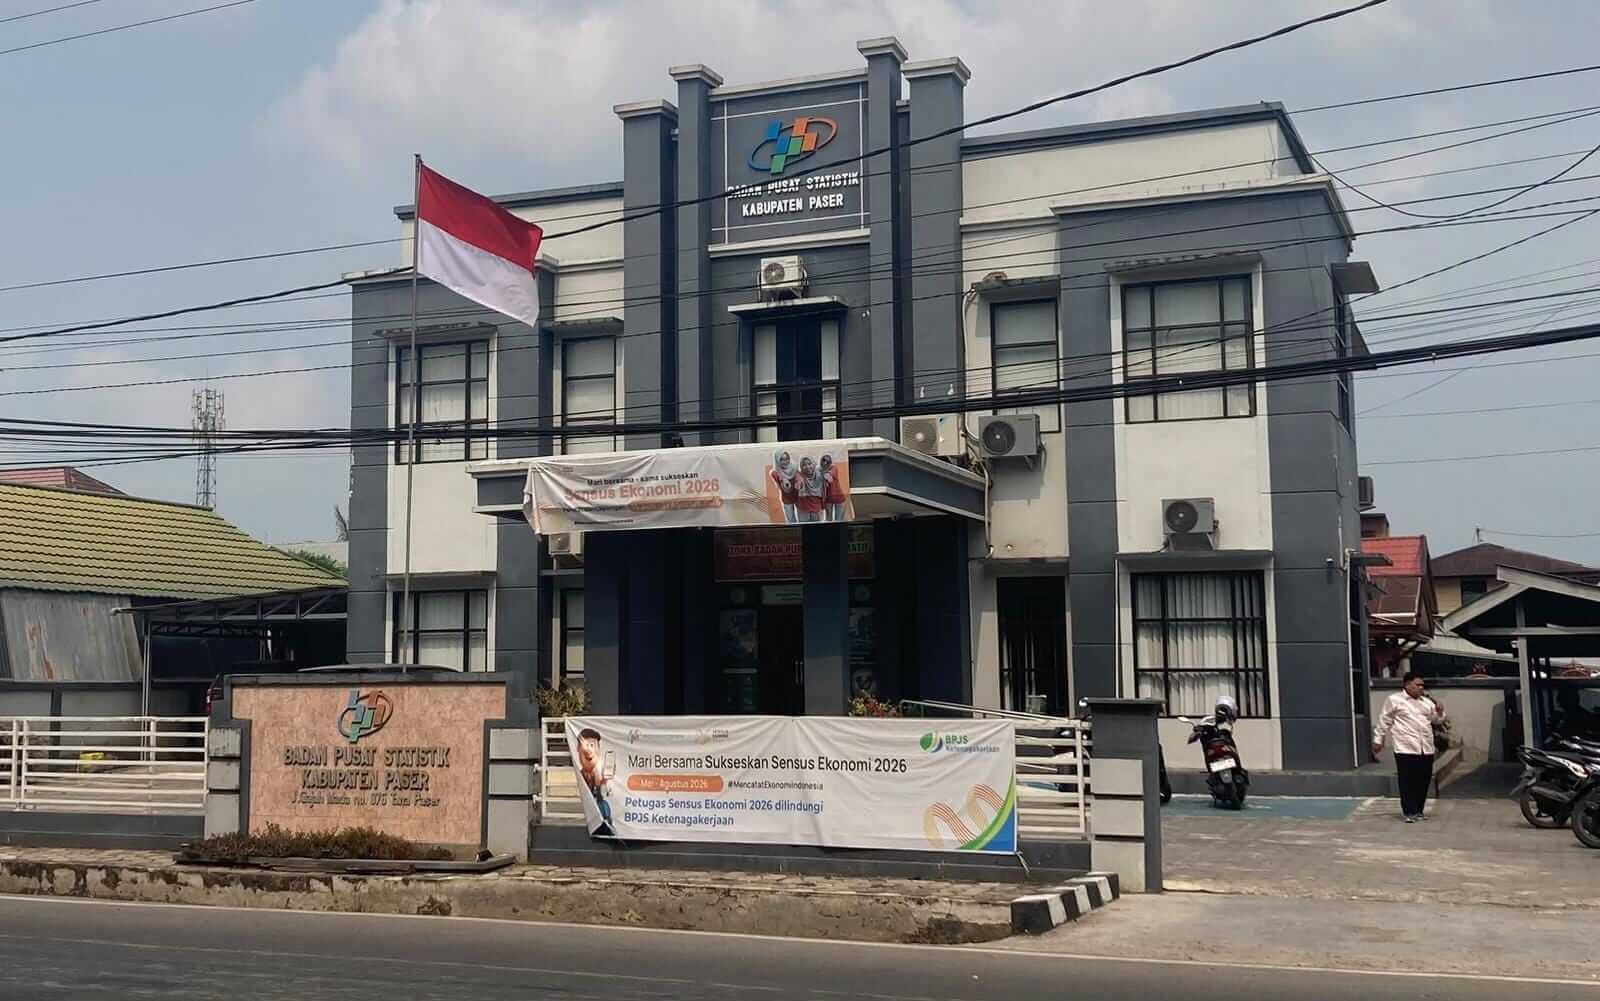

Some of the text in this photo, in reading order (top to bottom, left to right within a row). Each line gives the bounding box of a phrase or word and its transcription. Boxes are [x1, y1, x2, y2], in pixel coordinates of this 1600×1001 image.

[768, 178, 801, 194] PUSAT
[806, 171, 860, 190] STATISTIK
[742, 193, 844, 217] KABUPATEN PASER
[661, 471, 699, 480] sukseskan
[620, 480, 681, 499] Ekonomi
[686, 478, 720, 493] 2026
[945, 735, 968, 745] BPJS
[283, 747, 450, 768] BADAN PUSAT STATISTIK
[628, 754, 907, 773] Mari Bersama Sukseskan Sensus Ekonomi 2026
[302, 769, 430, 792] KABUPATEN PASER
[690, 778, 707, 789] 2026
[414, 791, 440, 807] Paser
[624, 797, 824, 814] Petugas Sensus Ekonomi 2026 dilindungi
[624, 812, 734, 827] BPJS Ketenagakerjaan
